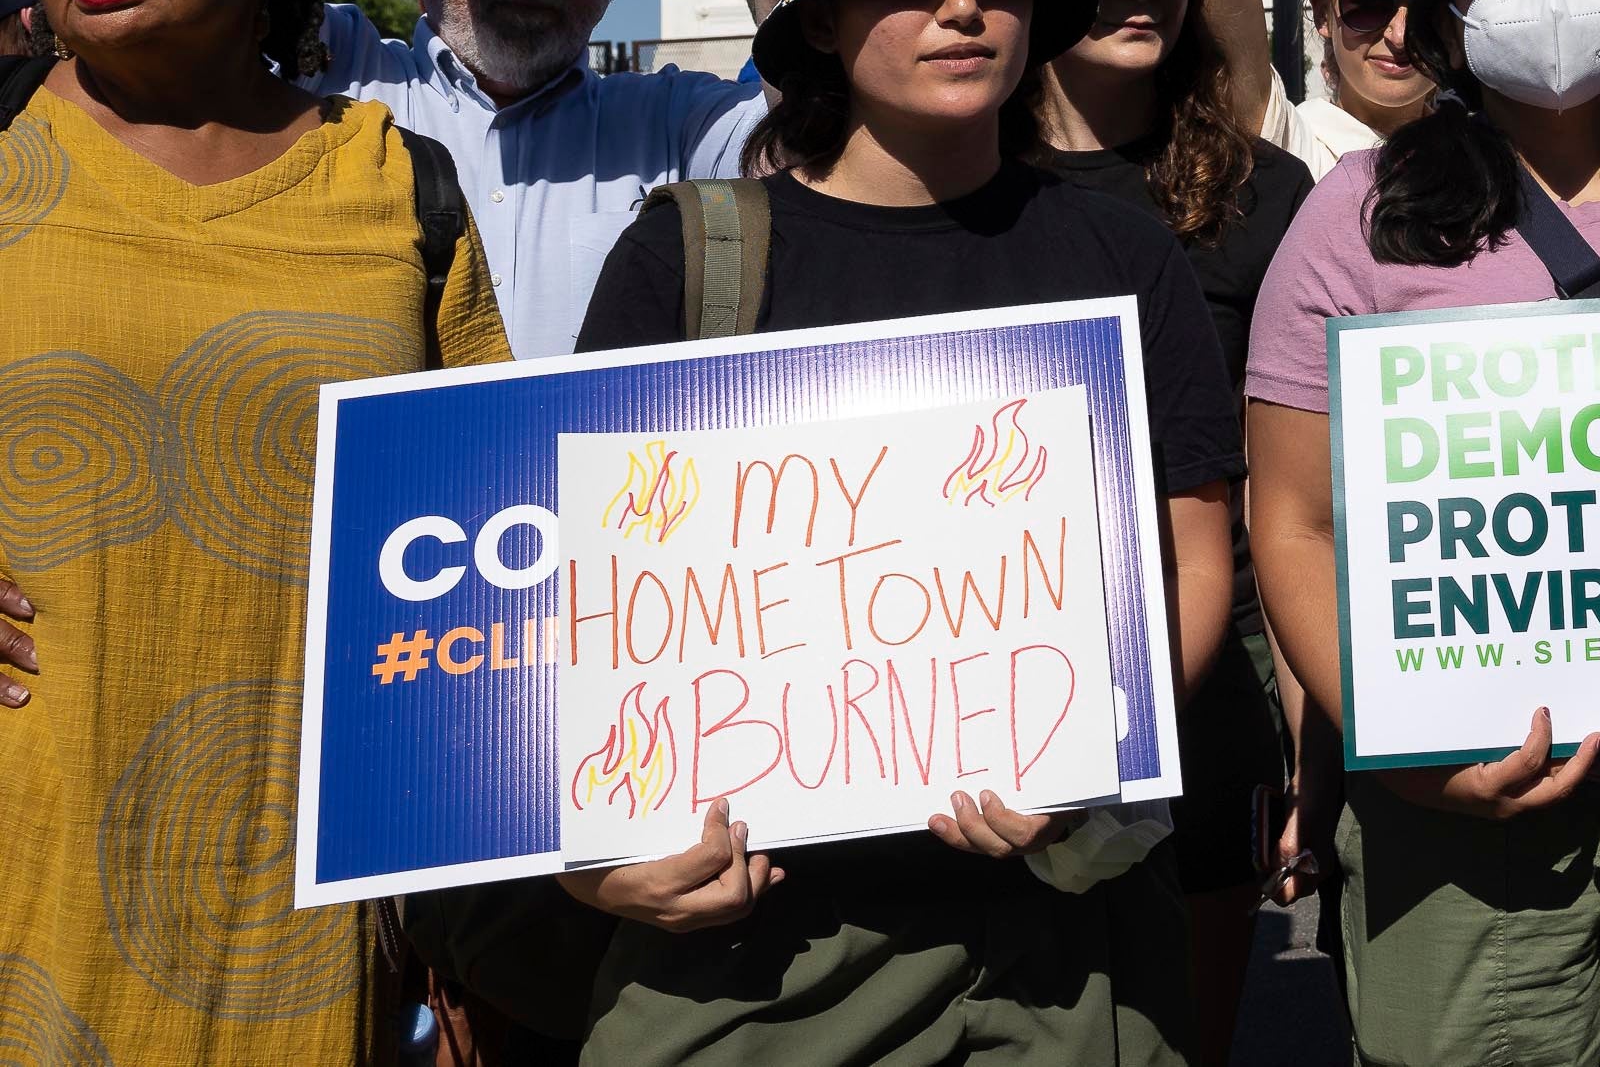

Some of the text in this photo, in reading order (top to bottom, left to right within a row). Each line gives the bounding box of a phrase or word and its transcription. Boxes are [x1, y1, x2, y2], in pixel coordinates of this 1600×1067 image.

[731, 445, 890, 549] MY
[378, 504, 559, 602] CO
[372, 616, 559, 684] #CLI
[691, 643, 1076, 814] BURNED
